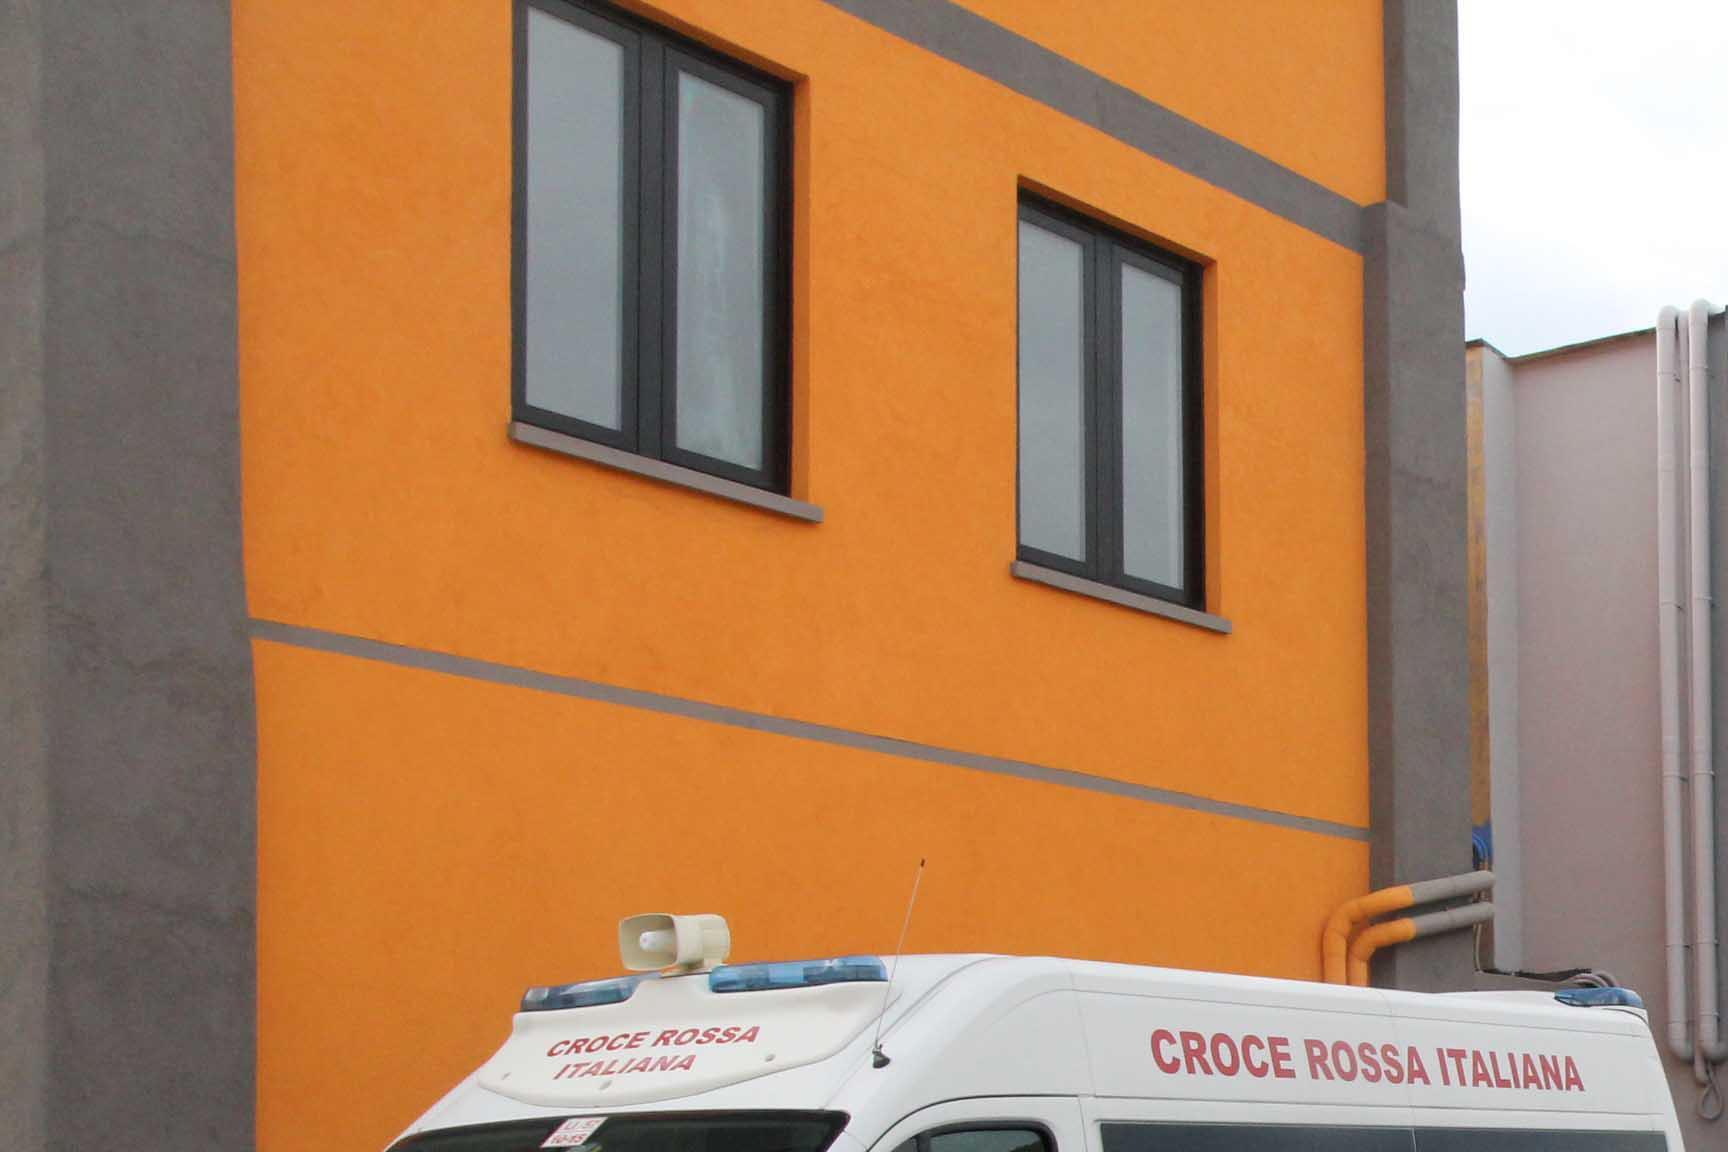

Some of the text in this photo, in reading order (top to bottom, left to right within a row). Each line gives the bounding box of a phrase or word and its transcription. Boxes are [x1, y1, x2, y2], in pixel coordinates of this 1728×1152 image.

[546, 1026, 760, 1058] CROCE ROSSA
[553, 1054, 696, 1080] ITALIANA
[1150, 1028, 1586, 1092] CROCE ROSSA ITALIANA
